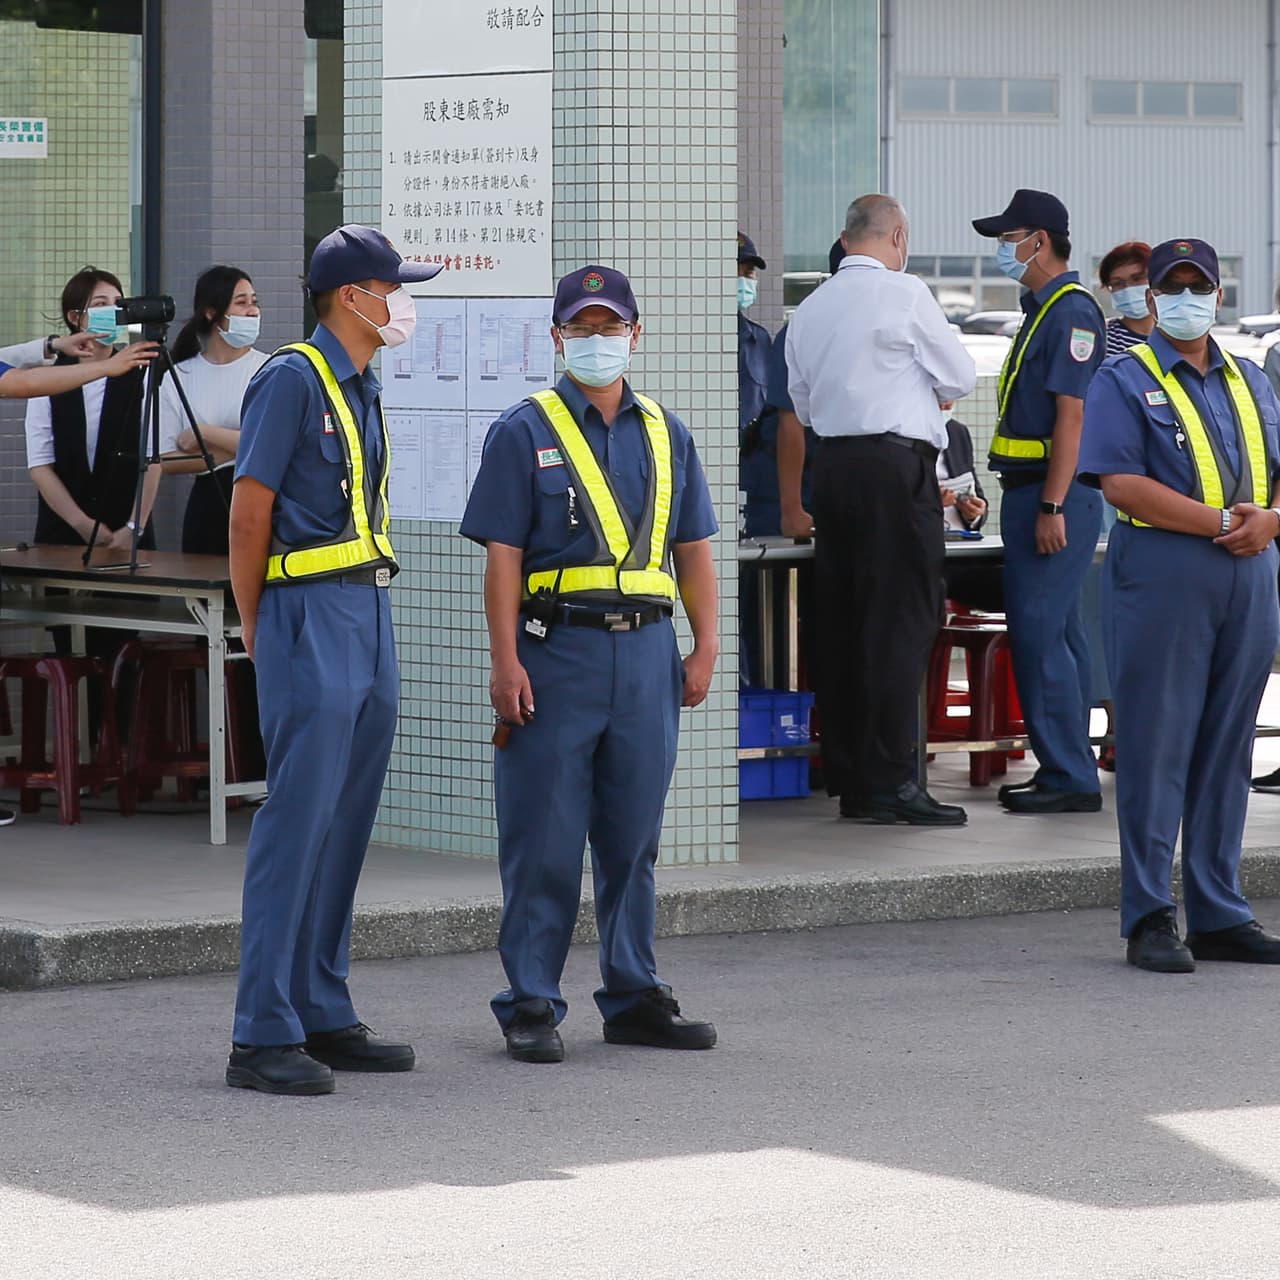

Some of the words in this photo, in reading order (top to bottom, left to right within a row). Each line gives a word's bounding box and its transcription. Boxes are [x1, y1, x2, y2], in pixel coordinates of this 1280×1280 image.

[486, 4, 545, 31] 敬請配合
[423, 97, 510, 123] 股東進廠需知
[388, 203, 397, 217] 2.
